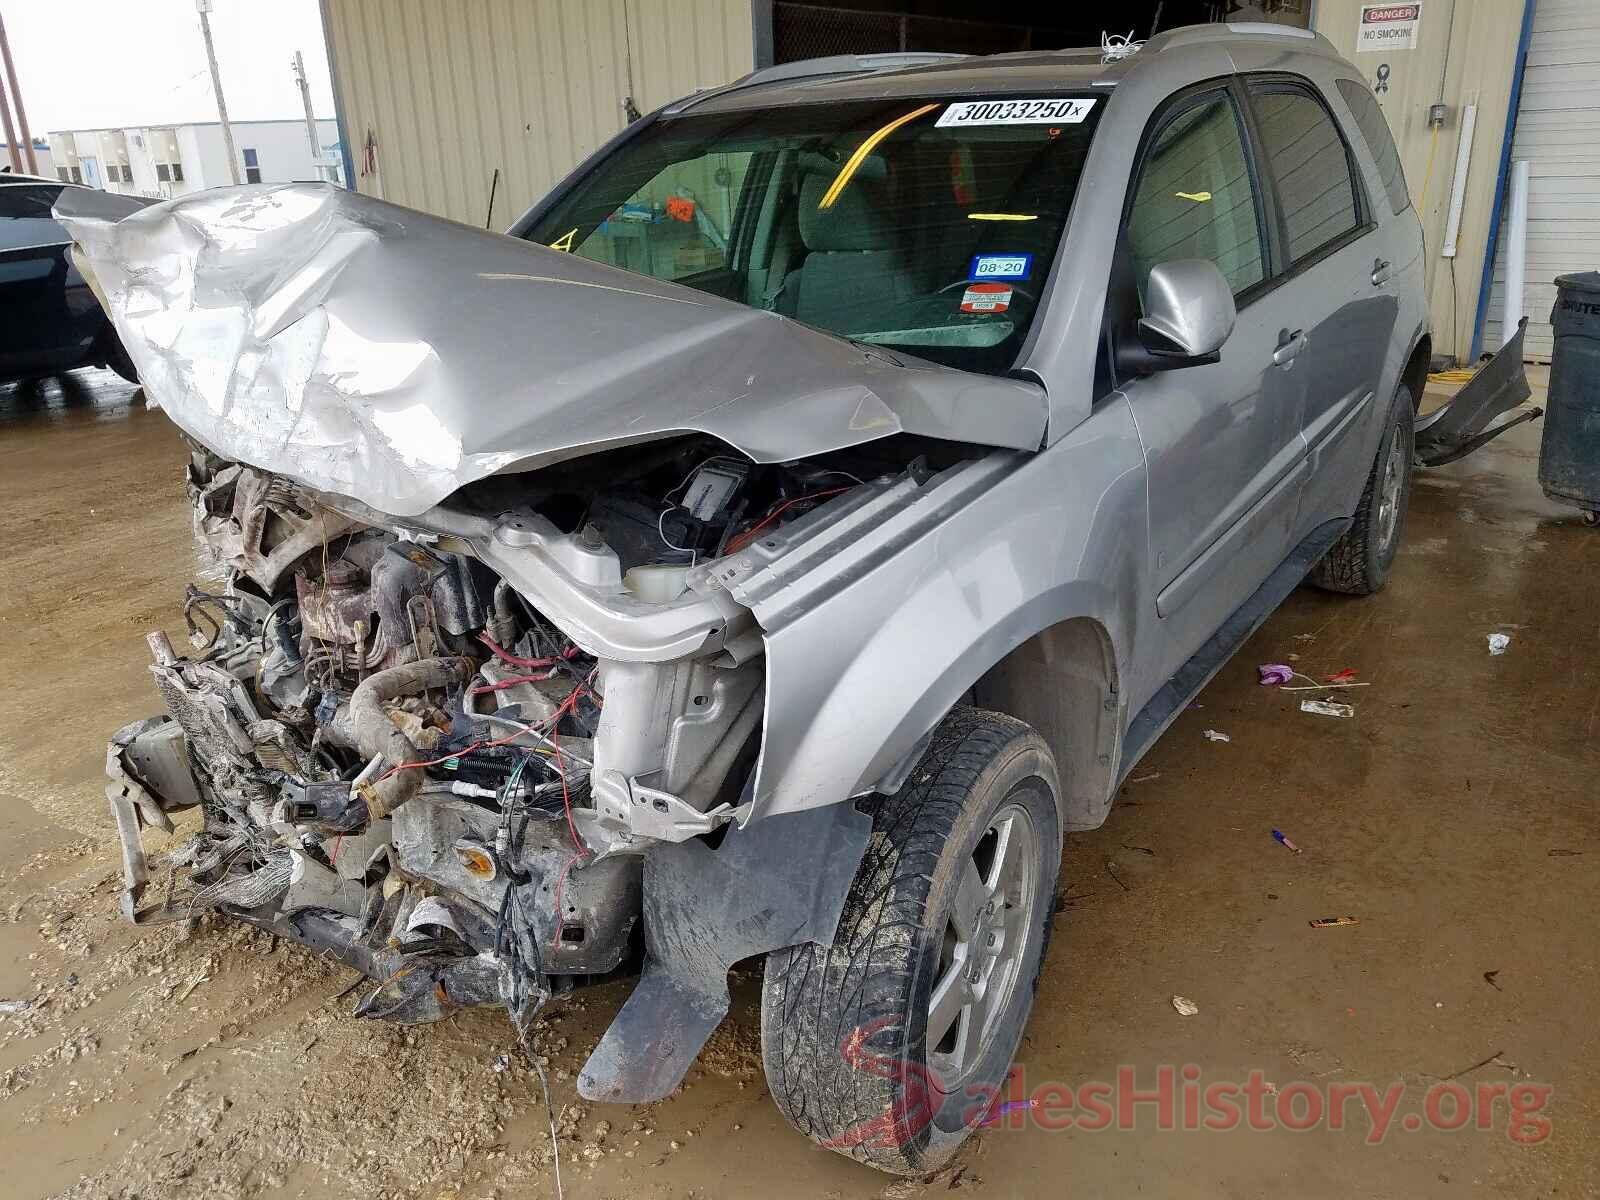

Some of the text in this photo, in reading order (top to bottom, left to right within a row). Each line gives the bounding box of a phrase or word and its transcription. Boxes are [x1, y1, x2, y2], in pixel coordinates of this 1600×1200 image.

[1370, 9, 1413, 20] DANGER
[1364, 31, 1375, 39] NO
[980, 263, 1022, 273] 08 20
